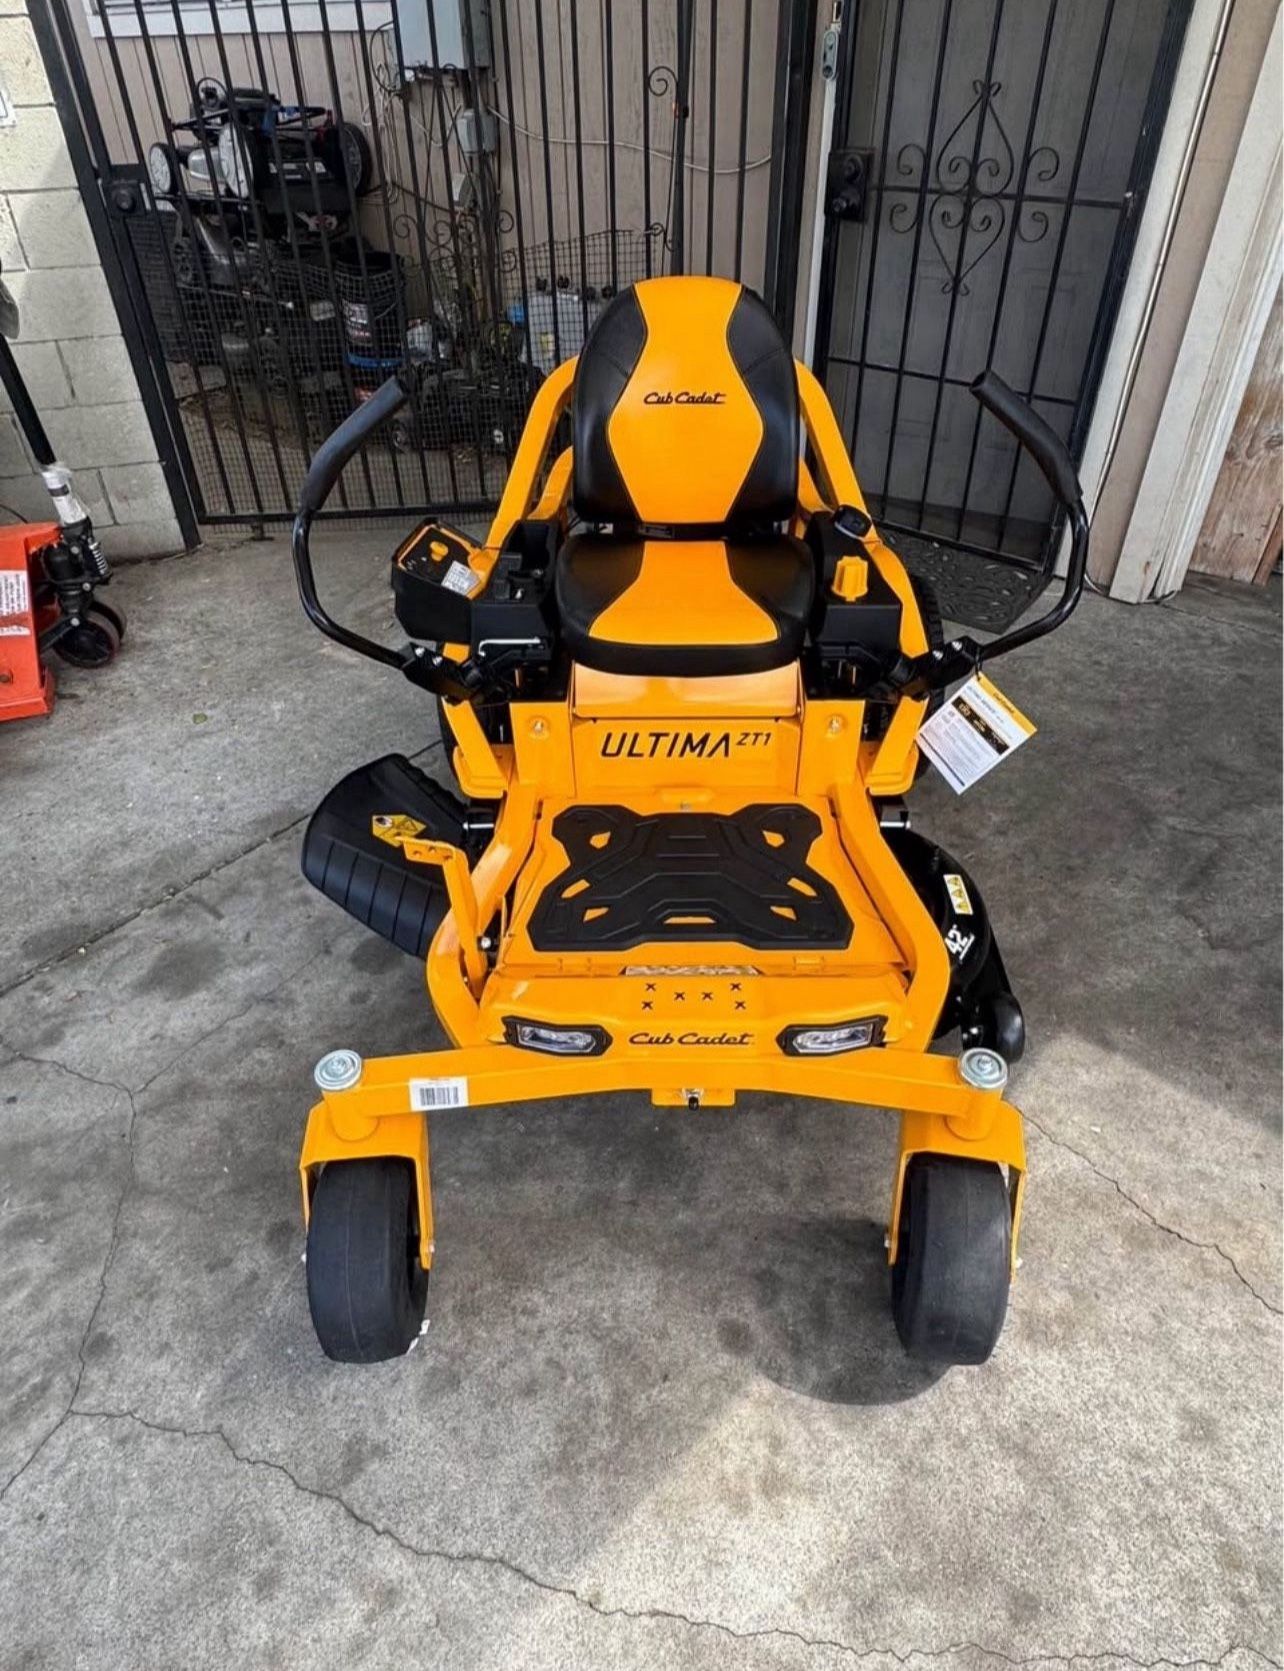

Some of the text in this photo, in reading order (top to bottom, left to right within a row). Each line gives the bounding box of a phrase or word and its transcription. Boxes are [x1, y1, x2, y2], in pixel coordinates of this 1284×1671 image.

[643, 392, 726, 405] Cub Cadet
[600, 732, 772, 758] ULTIMA ZT1
[629, 1032, 754, 1045] Cub Cadet
